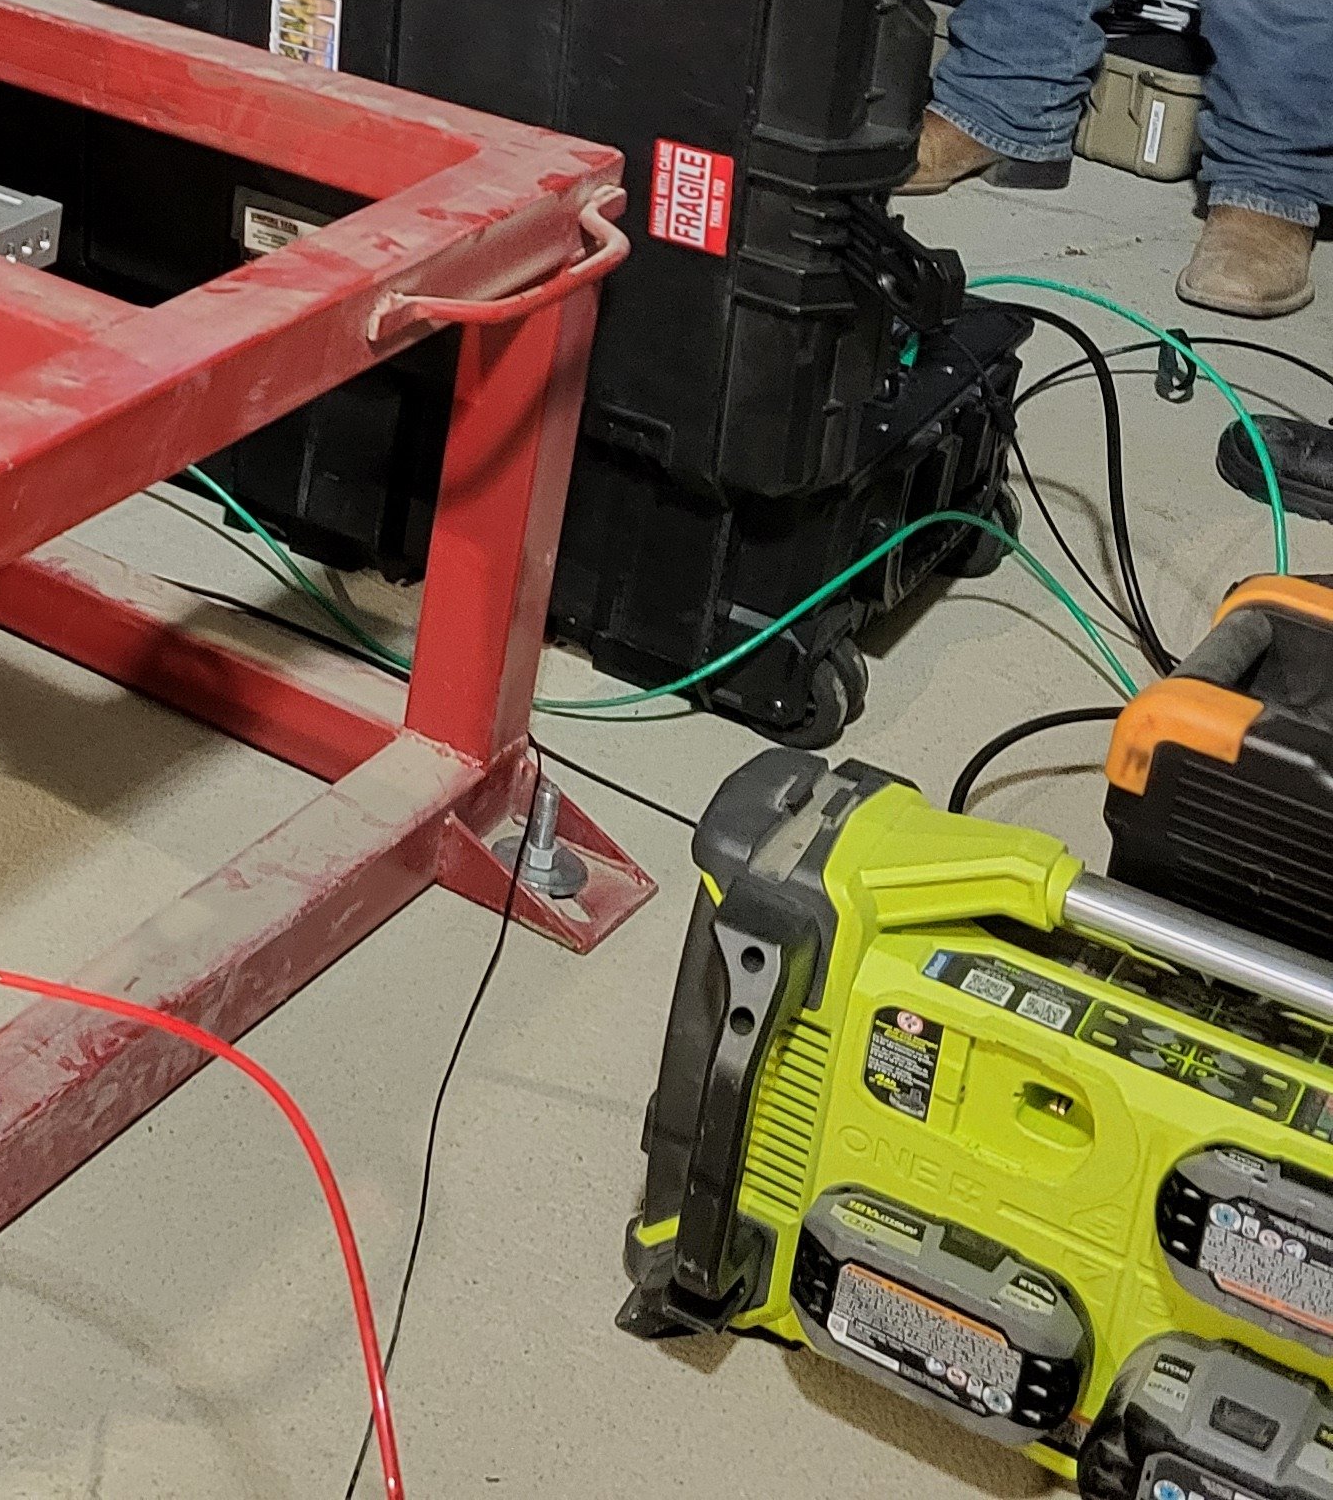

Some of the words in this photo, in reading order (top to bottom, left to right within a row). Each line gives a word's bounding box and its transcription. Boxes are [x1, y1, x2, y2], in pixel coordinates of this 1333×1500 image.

[658, 141, 673, 170] CARE
[674, 152, 706, 242] FRAGILE
[652, 197, 669, 238] HANDLE
[1018, 1277, 1055, 1303] RYOBI
